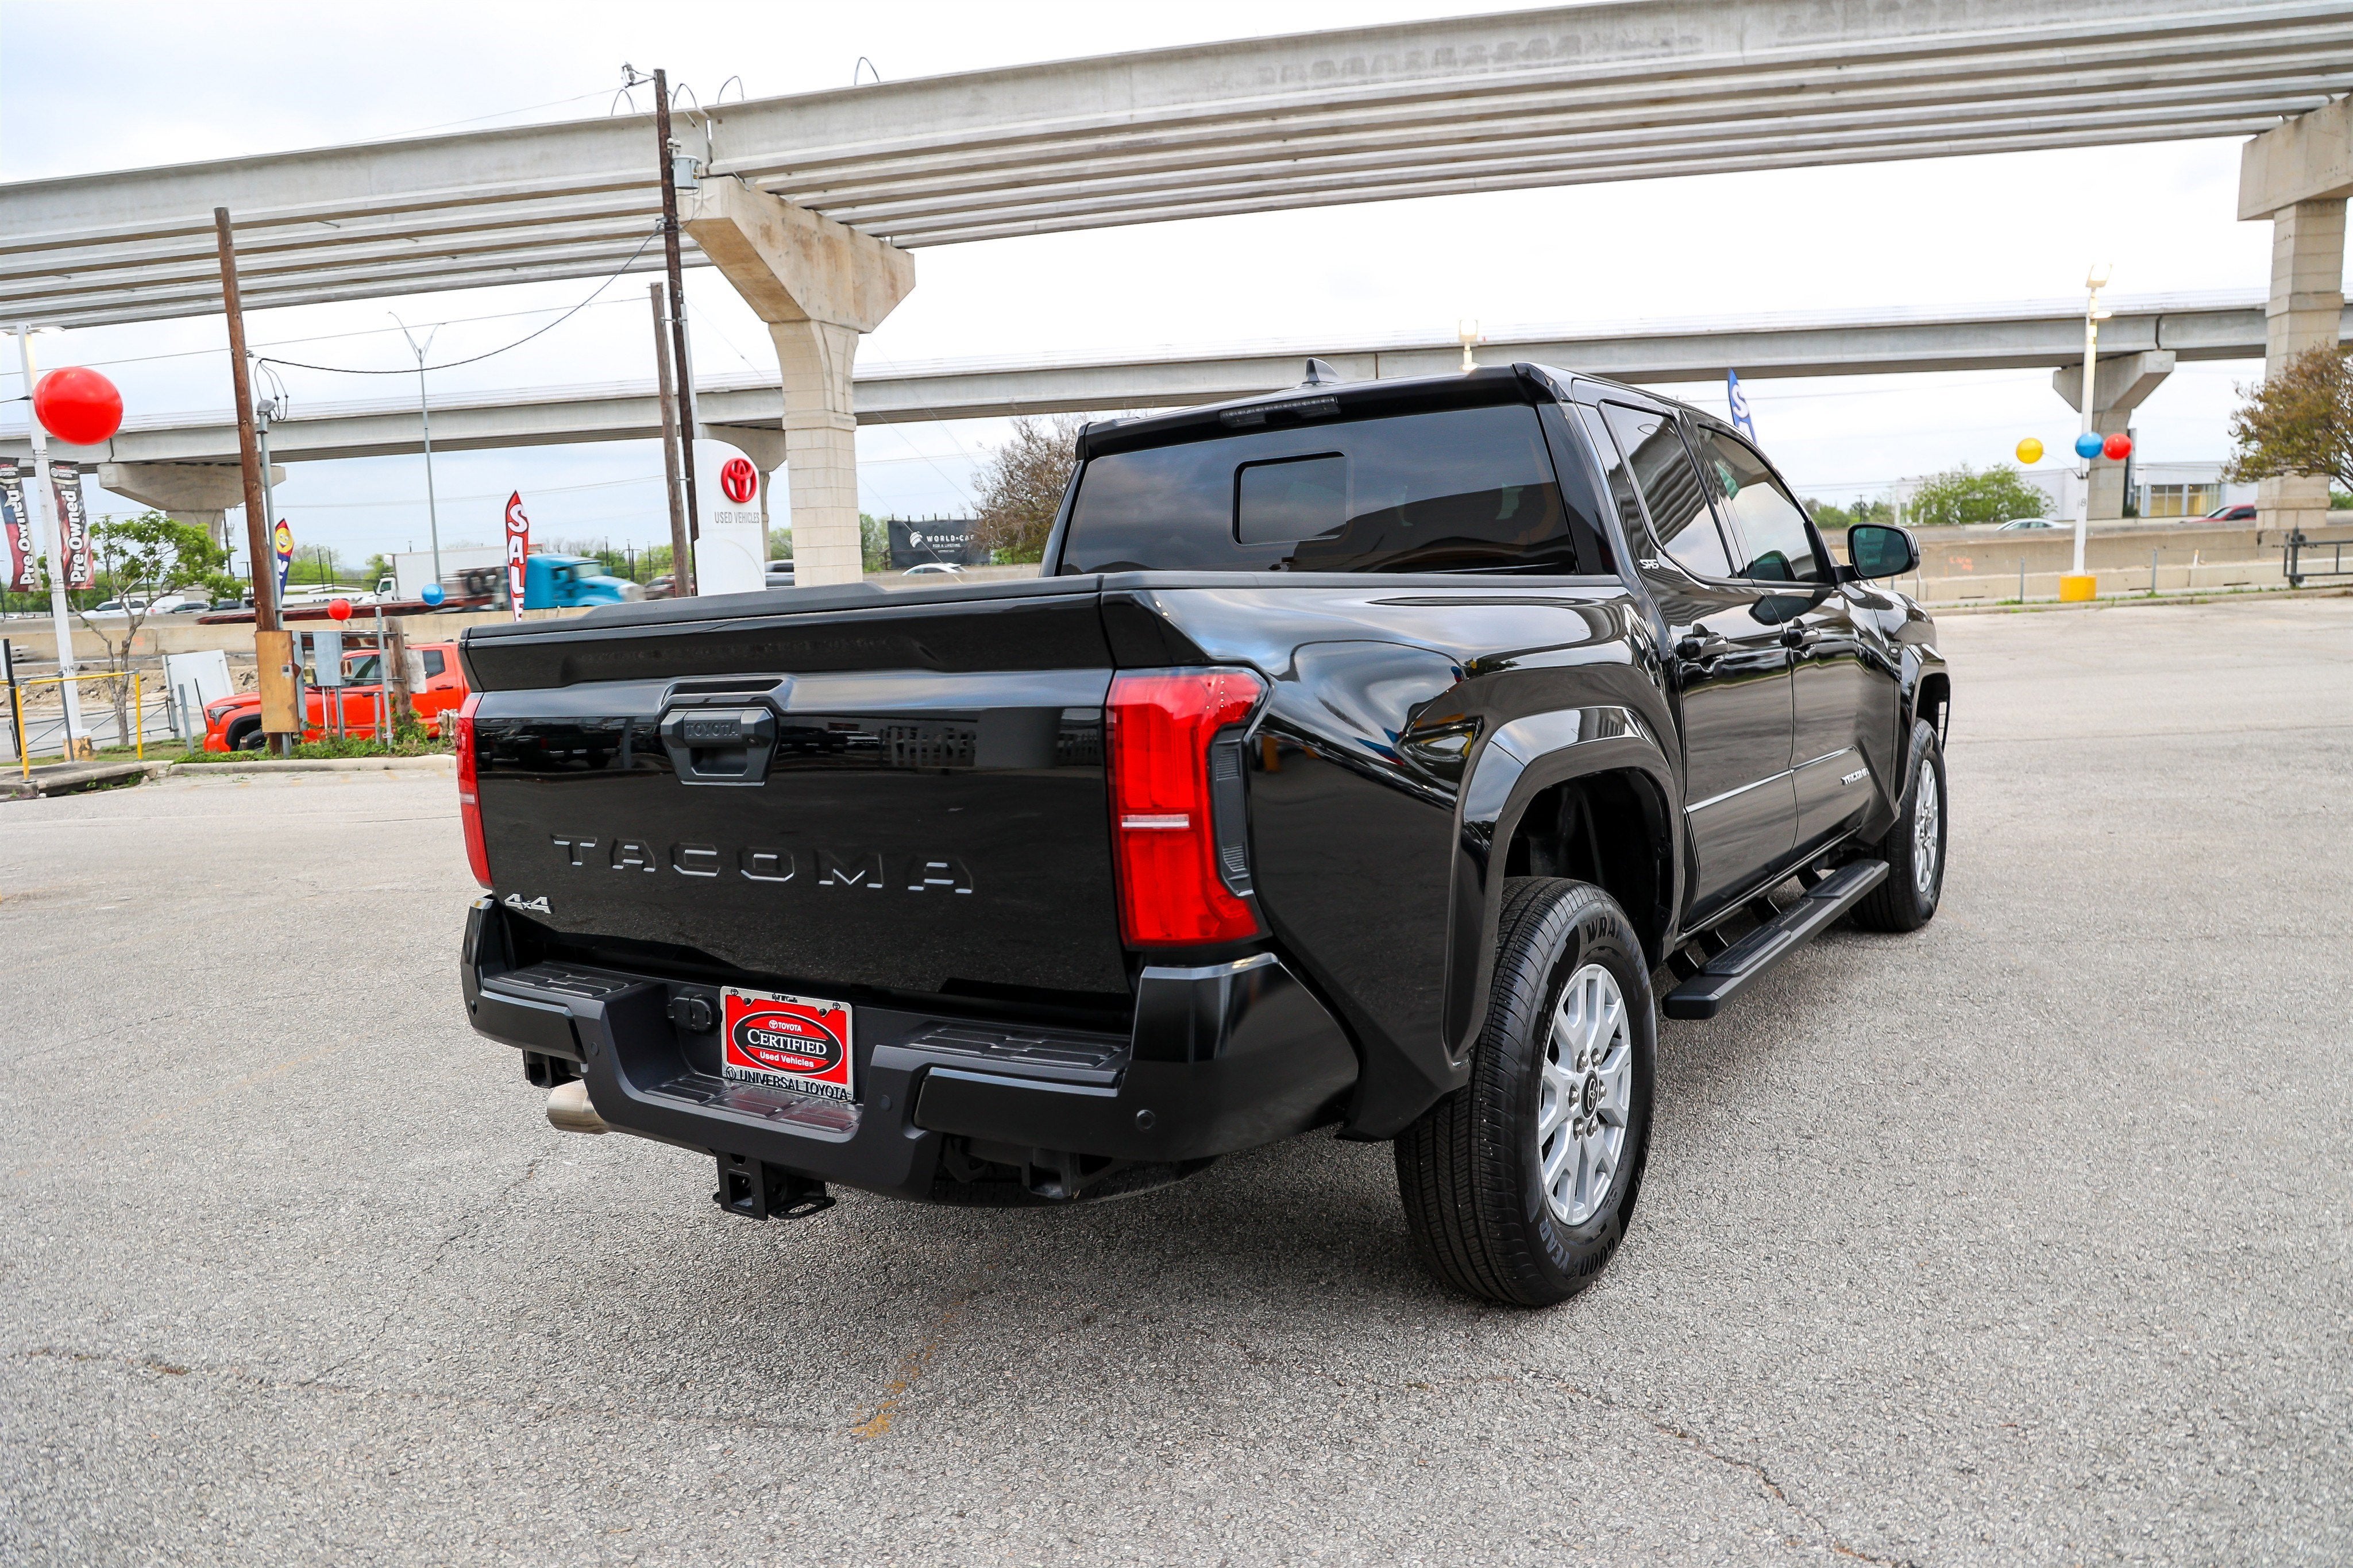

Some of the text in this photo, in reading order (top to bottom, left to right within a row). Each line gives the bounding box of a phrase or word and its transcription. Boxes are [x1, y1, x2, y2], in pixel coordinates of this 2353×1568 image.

[61, 490, 84, 551] Owned
[714, 512, 759, 524] USED VEHICLES
[20, 554, 35, 585] Pre
[70, 553, 85, 583] Pre
[508, 504, 529, 621] SALE
[685, 723, 739, 736] TOYOTA
[553, 835, 973, 894] TACOMA
[747, 1029, 827, 1055] CERTIFIED
[777, 1022, 802, 1032] TOYOTA
[760, 1051, 815, 1068] Used Vehicles
[740, 1069, 848, 1100] UNIVERSAL TOYOTA
